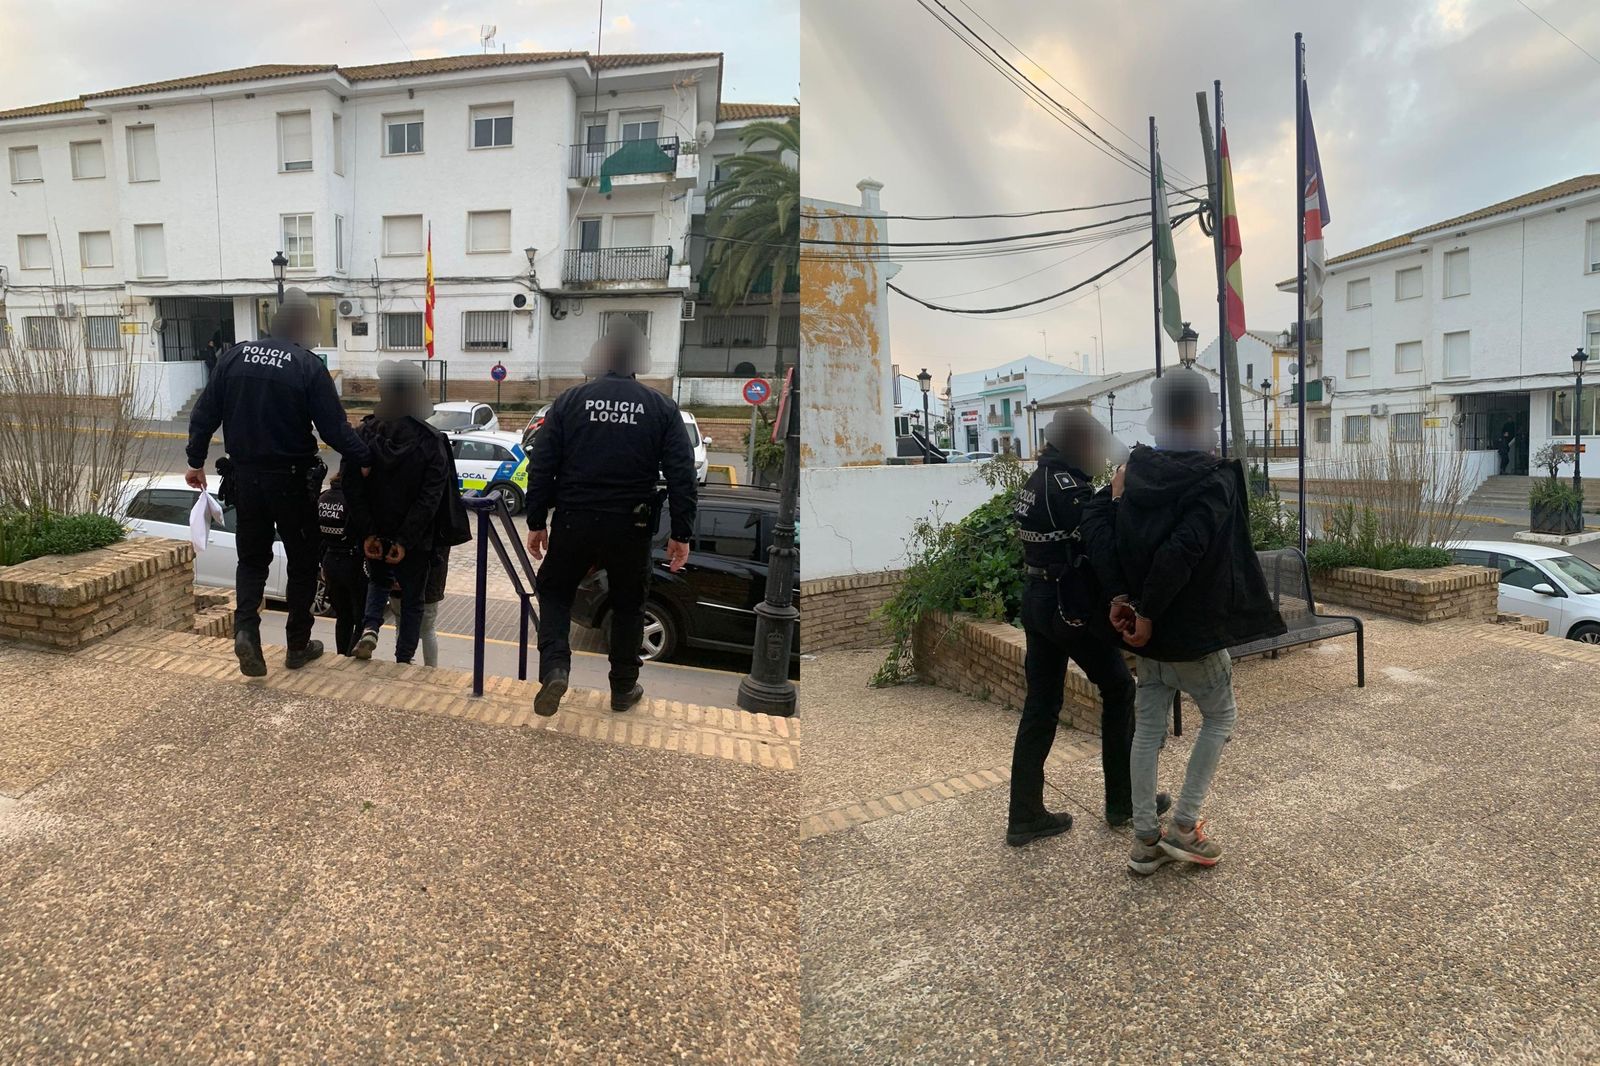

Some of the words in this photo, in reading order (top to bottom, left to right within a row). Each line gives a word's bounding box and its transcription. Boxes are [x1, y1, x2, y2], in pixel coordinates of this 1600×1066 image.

[242, 345, 292, 362] POLICIA
[243, 353, 284, 369] LOCAL
[585, 399, 645, 415] POLICIA
[590, 410, 638, 425] LOCAL
[457, 472, 488, 480] LOCAL
[318, 510, 340, 519] LOCAL
